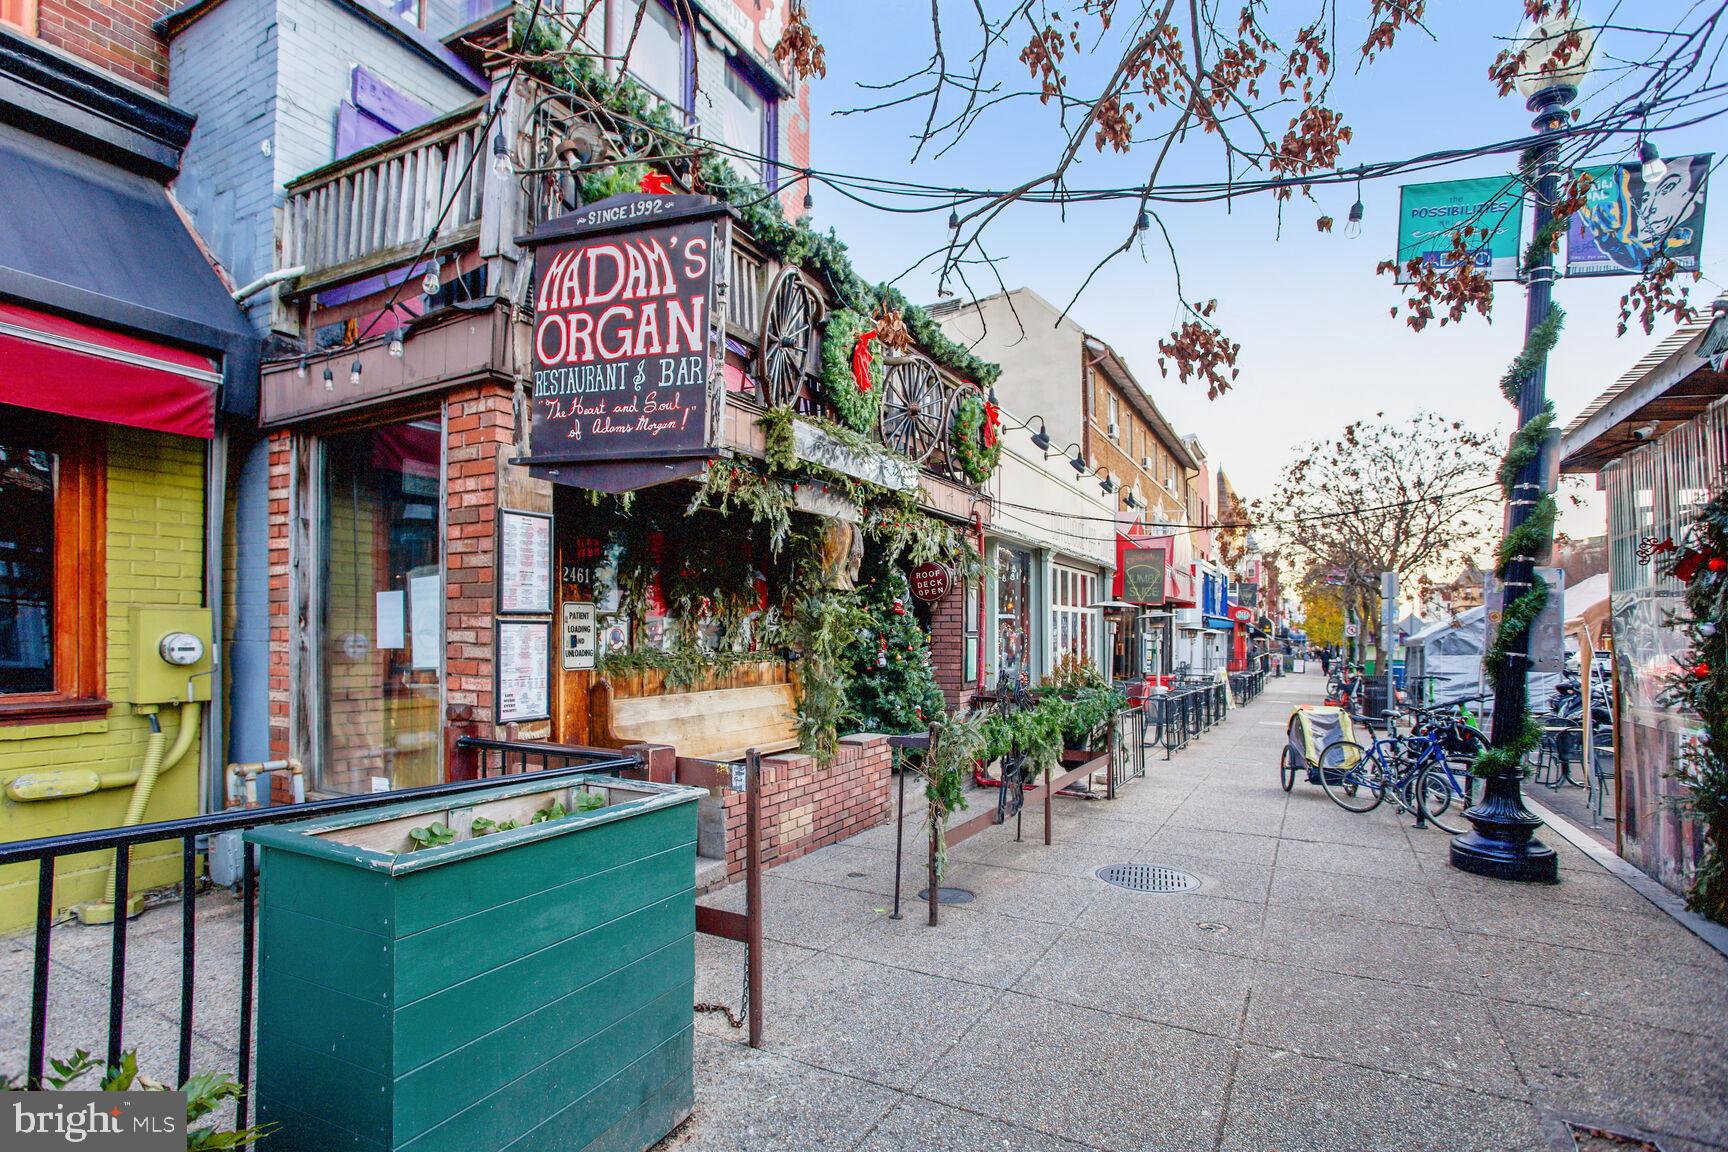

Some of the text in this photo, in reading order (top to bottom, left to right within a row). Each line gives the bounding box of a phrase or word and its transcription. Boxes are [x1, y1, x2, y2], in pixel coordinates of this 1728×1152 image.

[588, 199, 663, 225] SINCE 1992
[537, 236, 707, 311] MADAM'S
[536, 297, 704, 366] ORGAN
[534, 362, 629, 397] RESTAURANT
[658, 356, 703, 388] BAR
[567, 396, 607, 417] Heart
[613, 395, 638, 414] and
[643, 391, 681, 414] Soul
[567, 419, 582, 441] of
[592, 416, 634, 435] Adams
[562, 566, 590, 584] 2461
[915, 570, 940, 580] ROOF
[917, 578, 943, 589] DECK
[918, 587, 944, 597] OPEN
[568, 611, 590, 620] PATIENT
[567, 625, 591, 634] LOADING
